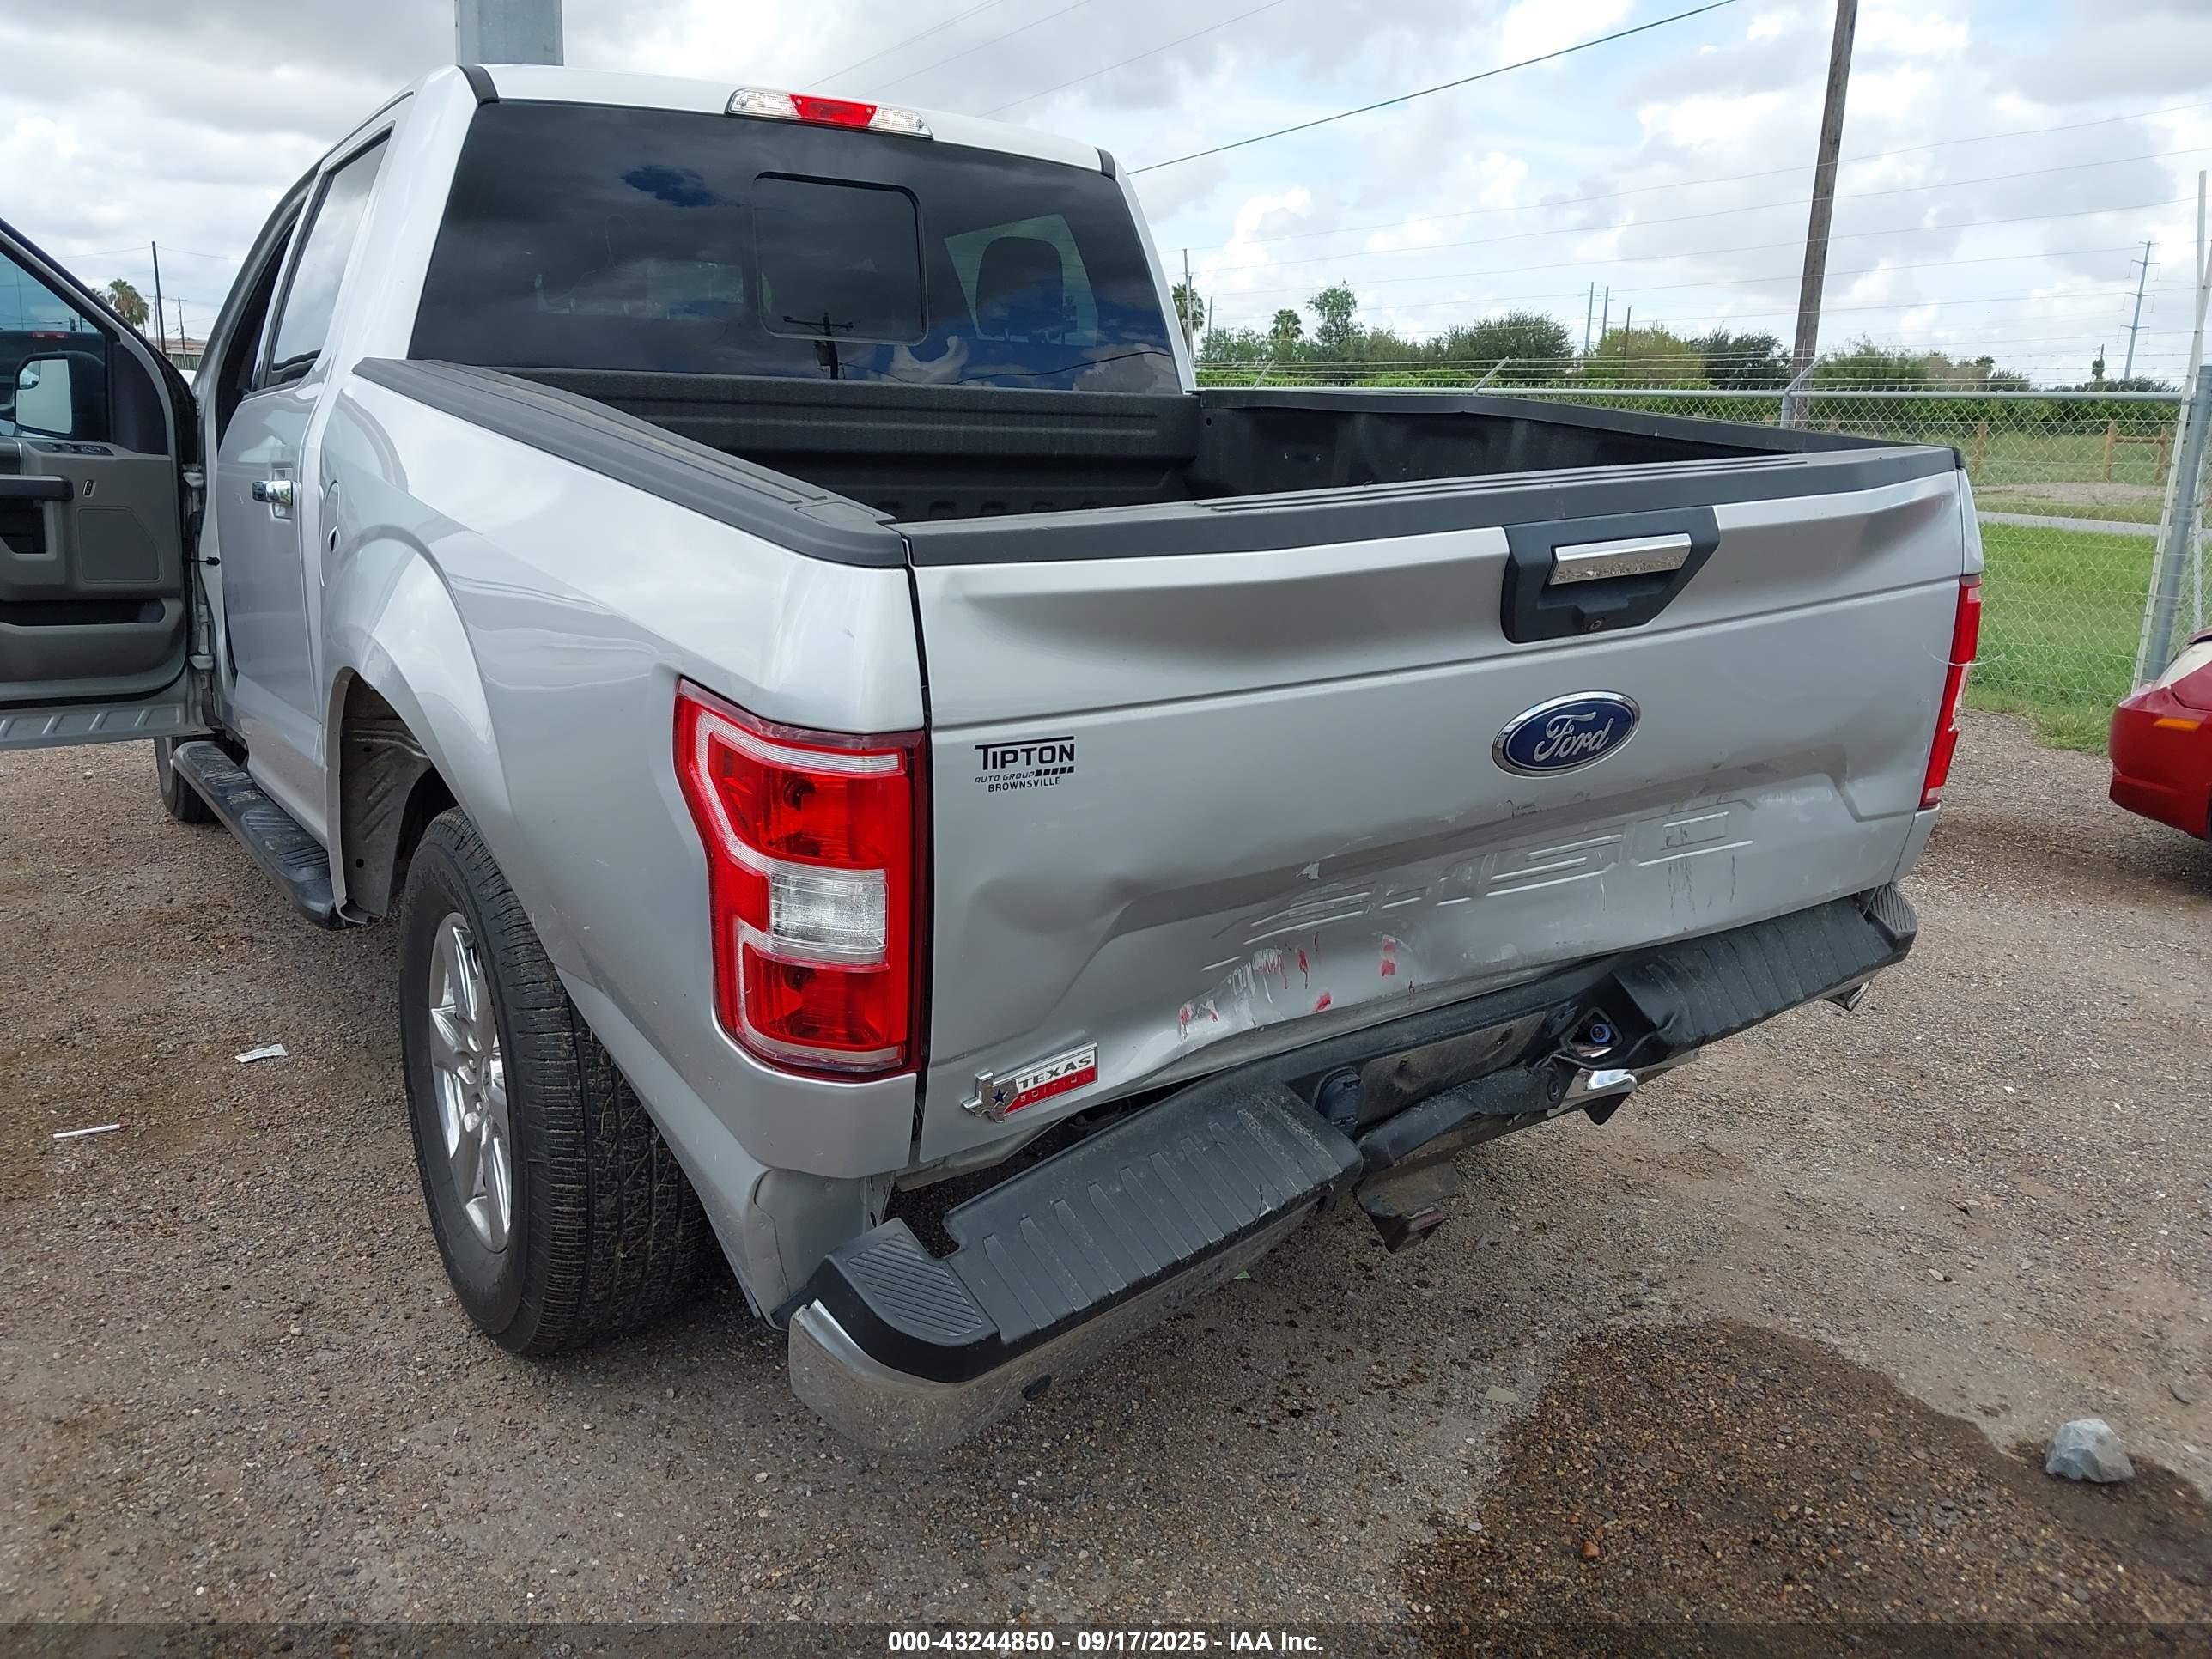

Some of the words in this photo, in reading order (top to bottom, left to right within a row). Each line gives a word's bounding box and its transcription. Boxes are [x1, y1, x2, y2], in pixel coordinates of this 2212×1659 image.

[974, 735, 1075, 770] TIPTON
[1534, 711, 1615, 762] Ford
[974, 775, 1000, 784] AUTO
[1002, 771, 1035, 781] GROUP
[988, 776, 1060, 793] BROWNSVILLE
[1018, 1055, 1091, 1089] TEXAS
